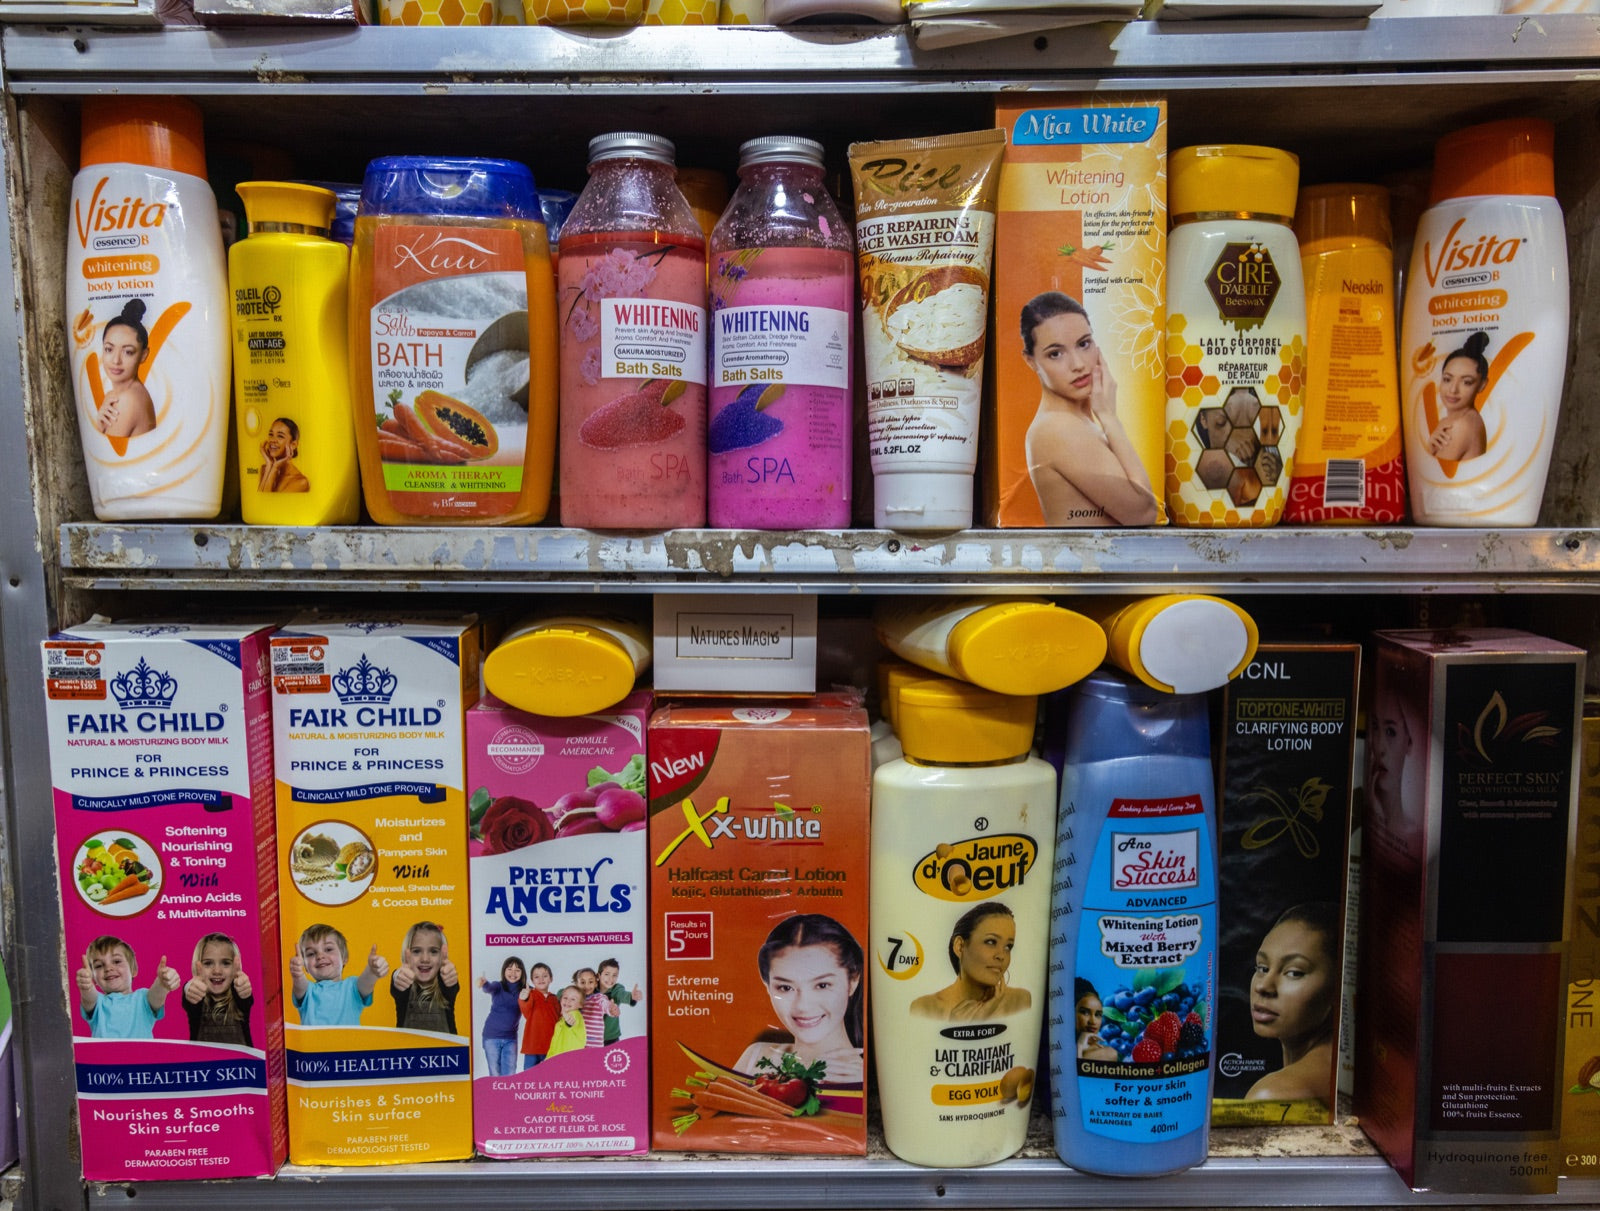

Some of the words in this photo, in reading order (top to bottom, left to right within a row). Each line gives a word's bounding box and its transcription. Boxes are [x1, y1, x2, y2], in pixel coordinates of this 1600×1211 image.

[1024, 114, 1072, 140] Mia
[1083, 113, 1146, 134] White
[1047, 169, 1125, 188] Whitening
[1060, 188, 1110, 205] Lotion
[874, 197, 938, 212] Re-generation
[75, 176, 167, 249] Visita
[857, 223, 884, 240] RICE
[887, 217, 970, 234] REPAIRING
[887, 233, 931, 246] WASH
[933, 231, 979, 244] FOAM
[1424, 217, 1521, 288] Visita
[87, 259, 152, 274] whitening
[1217, 262, 1273, 284] CIRE
[87, 281, 113, 292] body
[118, 279, 154, 290] lotion
[1084, 276, 1109, 285] Fortified
[1341, 279, 1384, 295] Neoskin
[235, 288, 261, 301] SOLEIL
[236, 301, 278, 316] PROTECT
[1434, 294, 1501, 311] whitening
[613, 304, 699, 332] WHITENING
[721, 311, 809, 333] WHITENING
[1432, 315, 1459, 327] body
[1463, 313, 1499, 324] lotion
[249, 339, 283, 349] ANTI-AGE
[1206, 347, 1236, 355] BODY
[1241, 347, 1277, 355] LOTION
[377, 342, 443, 367] BATH
[617, 348, 645, 356] SAKURA
[645, 349, 684, 359] MOISTURIZER
[723, 353, 745, 362] Lavender
[745, 353, 787, 362] Aromatherapy
[616, 362, 648, 375] Bath
[652, 363, 683, 377] Salts
[722, 370, 747, 382] Bath
[750, 368, 783, 380] Salts
[1227, 371, 1239, 379] DE
[1240, 371, 1260, 379] PEAU
[900, 397, 931, 406] Darkness
[938, 399, 957, 408] Spots
[650, 452, 692, 481] SPA
[722, 471, 743, 484] Bath
[747, 457, 796, 484] SPA
[407, 471, 447, 479] AROMA
[451, 471, 503, 480] THERAPY
[1067, 506, 1105, 519] 300ml
[690, 625, 740, 646] NATURES
[1240, 702, 1343, 717] TOPTONE-WHITE
[67, 713, 129, 733] FAIR
[137, 712, 225, 733] CHILD
[289, 708, 348, 727] FAIR
[356, 707, 442, 727] CHILD
[1236, 722, 1308, 735] CLARIFYING
[1310, 722, 1344, 734] BODY
[566, 736, 608, 745] FORMULE
[1267, 738, 1312, 751] LOTION
[136, 754, 162, 763] FOR
[354, 748, 379, 756] FOR
[71, 767, 129, 778] PRINCE
[134, 767, 144, 777] &
[149, 766, 229, 777] PRINCESS
[291, 760, 347, 771] PRINCE
[352, 760, 362, 770] &
[367, 759, 444, 770] PRINCESS
[650, 751, 705, 784] New
[165, 825, 227, 838] Softening
[399, 832, 423, 842] and
[161, 841, 233, 853] Nourishing
[378, 848, 423, 859] Pampers
[425, 847, 448, 856] Skin
[966, 841, 1023, 862] Jaune
[1133, 850, 1186, 871] Skin
[392, 864, 430, 879] With
[509, 857, 614, 885] PRETTY
[485, 883, 632, 927] ANGELS
[1126, 895, 1188, 907] ADVANCED
[670, 920, 698, 929] Results
[699, 920, 707, 928] in
[1102, 918, 1163, 932] Whitening
[1165, 916, 1198, 929] Lotion
[489, 936, 519, 944] LOTION
[521, 935, 546, 944] ÉCLAT
[548, 935, 586, 943] ENFANTS
[587, 934, 631, 943] NATURELS
[669, 930, 686, 953] 5
[684, 930, 709, 939] Jours
[1105, 941, 1153, 953] Mixed
[1157, 939, 1197, 952] Berry
[1121, 952, 1182, 965] Extract
[667, 975, 720, 986] Extreme
[667, 990, 734, 1003] Whitening
[667, 1005, 710, 1016] Lotion
[935, 1049, 958, 1063] LAIT
[962, 1043, 1011, 1062] TRAITANT
[295, 1059, 330, 1074] 100%
[334, 1056, 415, 1073] HEALTHY
[419, 1054, 460, 1069] SKIN
[87, 1072, 124, 1086] 100%
[128, 1069, 210, 1085] HEALTHY
[216, 1067, 257, 1082] SKIN
[949, 1090, 972, 1100] EGG
[975, 1085, 999, 1100] YOLK
[1114, 1082, 1134, 1092] For
[1137, 1083, 1162, 1095] your
[1165, 1079, 1186, 1091] skin
[1442, 1084, 1461, 1092] with
[1462, 1084, 1508, 1092] multi-fruits
[1509, 1084, 1542, 1092] Extracts
[299, 1096, 372, 1109] Nourishes
[377, 1095, 387, 1106] &
[393, 1091, 455, 1105] Smooths
[1104, 1095, 1140, 1107] softer
[1144, 1096, 1153, 1106] &
[1156, 1091, 1192, 1105] smooth
[1442, 1101, 1489, 1109] Glutathione
[332, 1110, 363, 1123] Skin
[368, 1108, 422, 1122] surface
[524, 1115, 568, 1124] CAROTTE
[571, 1114, 596, 1122] ROSE
[128, 1122, 160, 1135] Skin
[165, 1121, 220, 1135] surface
[504, 1125, 543, 1134] EXTRAIT
[545, 1125, 557, 1133] DE
[559, 1124, 585, 1133] FLEUR
[588, 1124, 599, 1132] DE
[601, 1123, 627, 1132] ROSE
[145, 1148, 186, 1157] PARABEN
[187, 1147, 208, 1156] FREE
[124, 1159, 198, 1168] DERMATOLOGIST
[199, 1157, 230, 1165] TESTED
[1580, 1154, 1597, 1165] 300
